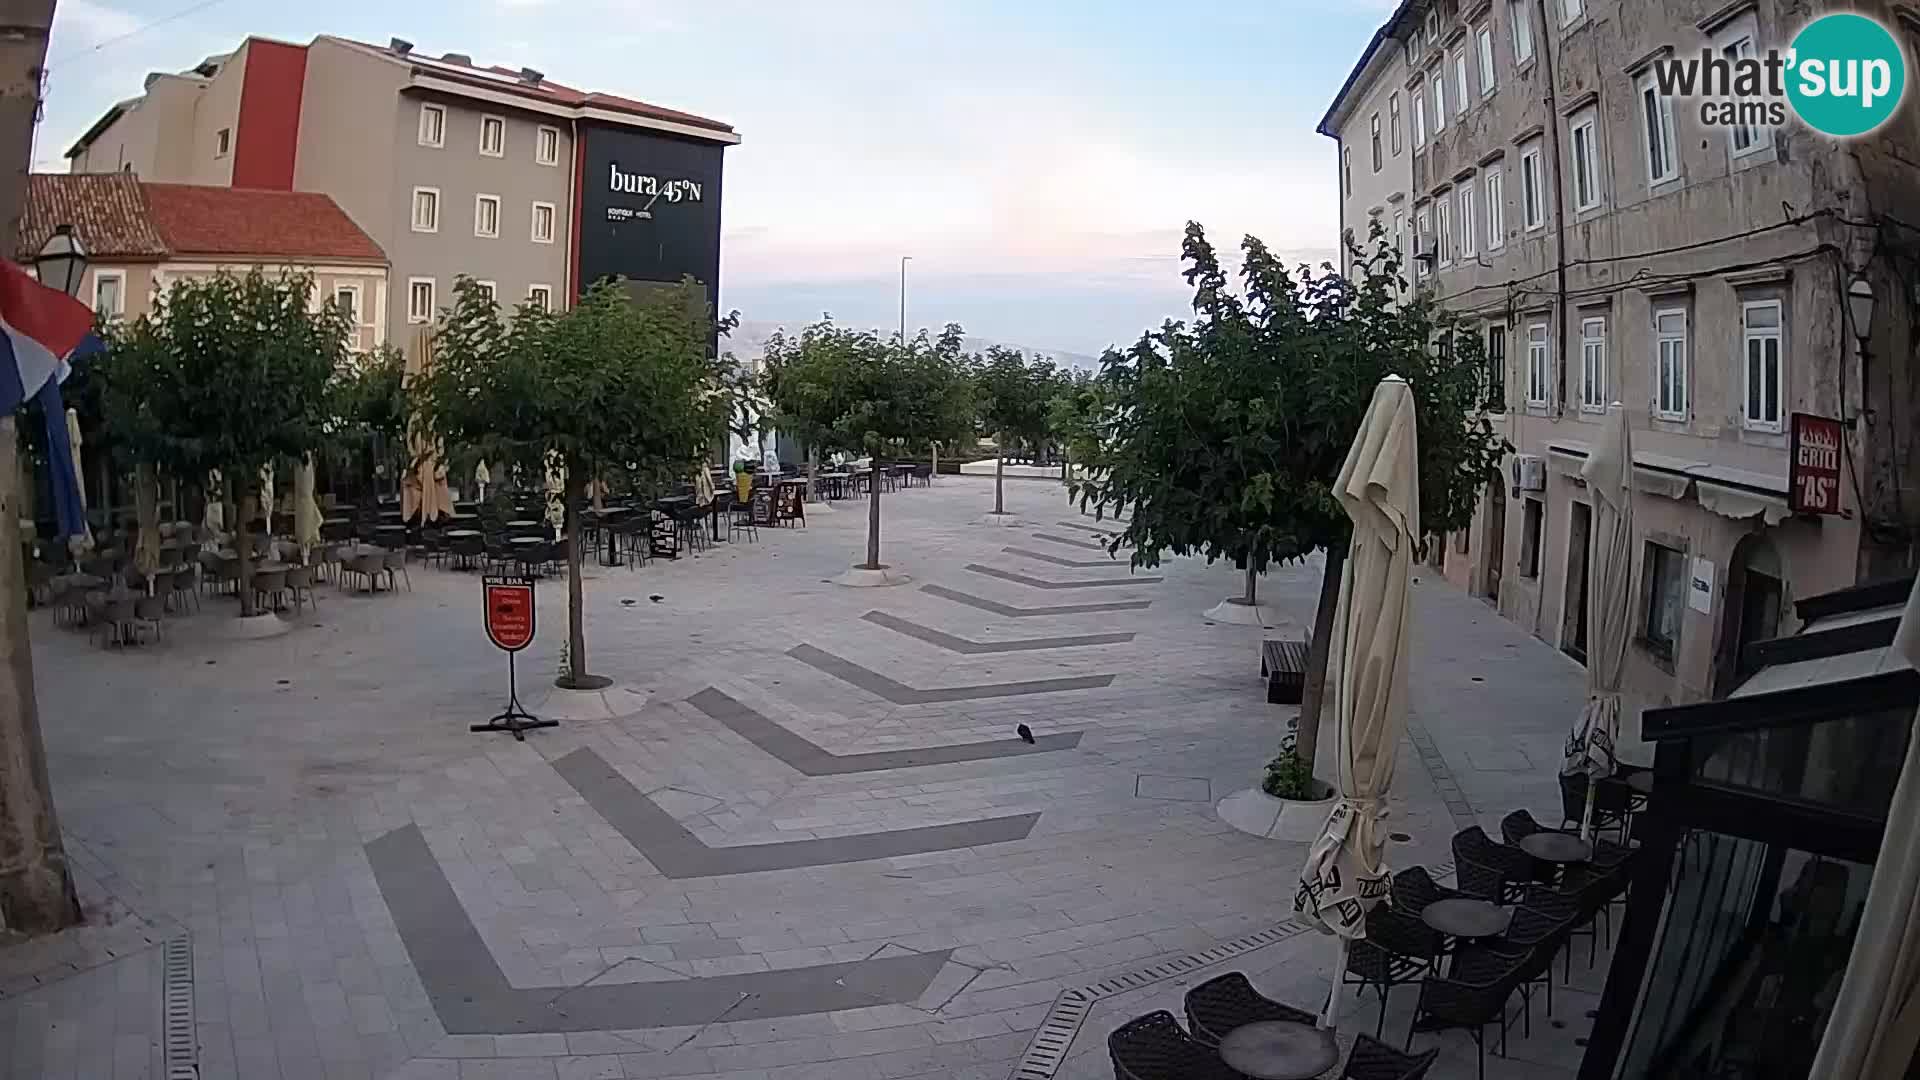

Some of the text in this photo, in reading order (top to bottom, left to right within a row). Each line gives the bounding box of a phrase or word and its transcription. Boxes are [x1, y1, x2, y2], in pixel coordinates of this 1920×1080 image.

[610, 164, 657, 195] bura
[1799, 448, 1838, 470] GRILL
[506, 577, 523, 585] BAR
